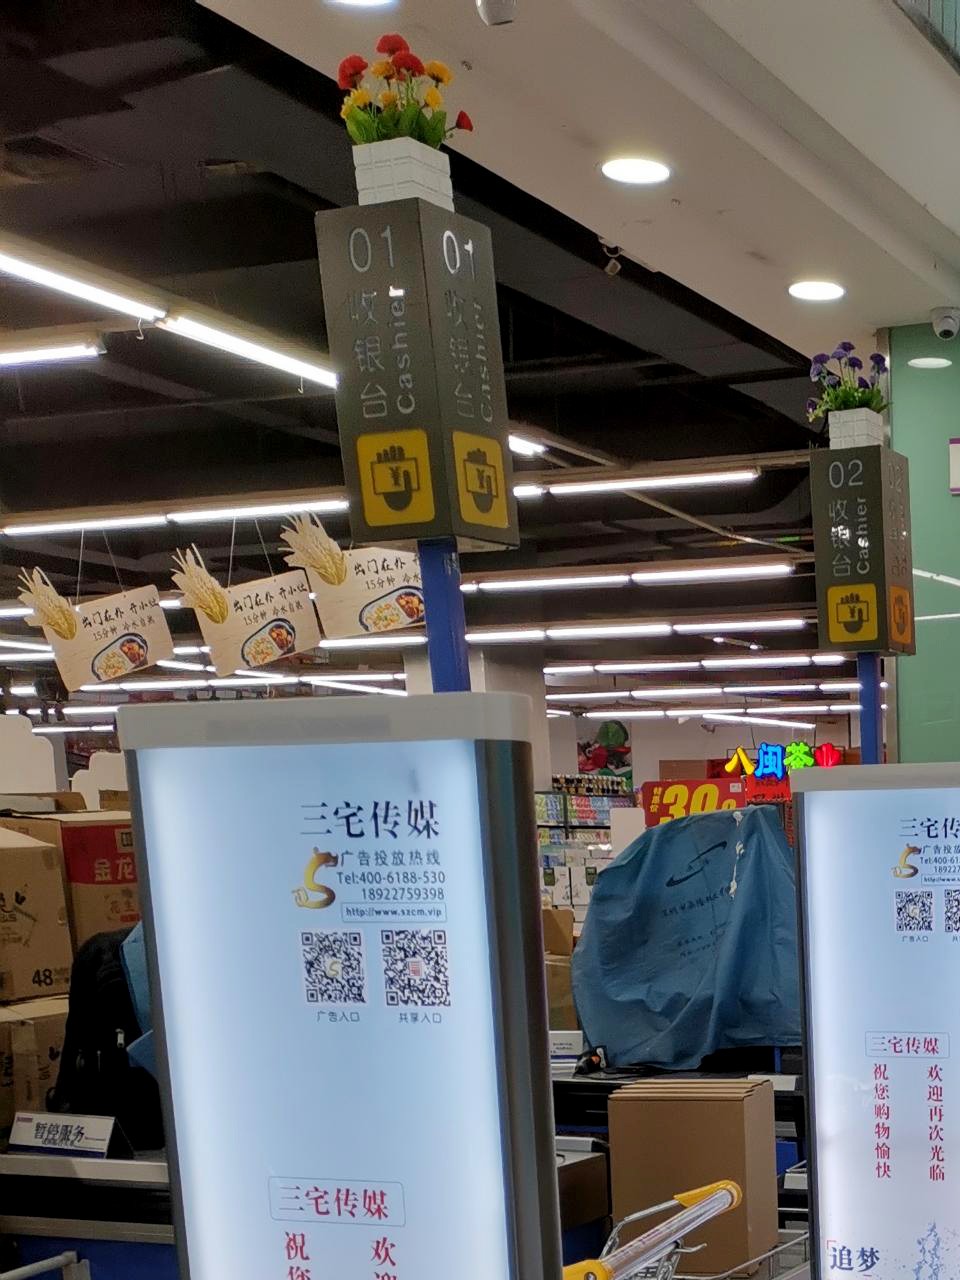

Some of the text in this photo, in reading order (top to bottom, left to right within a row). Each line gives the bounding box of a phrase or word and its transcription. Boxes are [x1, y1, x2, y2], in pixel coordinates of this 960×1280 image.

[350, 225, 394, 273] 01
[443, 230, 475, 280] 01
[389, 285, 415, 414] Cashier
[828, 459, 864, 488] 02
[829, 498, 851, 577] 收银台
[856, 497, 870, 574] Cashier
[300, 800, 439, 839] 三宅传媒
[340, 850, 441, 867] 广告投放热线
[336, 871, 446, 884] Tel:400-6188-530
[361, 888, 445, 900] 18922759398
[32, 969, 53, 986] 48
[316, 1010, 360, 1022] 广告入口
[398, 1012, 442, 1024] 共享入口
[871, 1036, 939, 1055] 三宅传媒
[873, 1063, 891, 1179] 祝您购物愉快
[926, 1063, 945, 1182] 欢迎再次光临
[278, 1186, 389, 1220] 三宅传媒
[830, 1245, 880, 1273] 追梦
